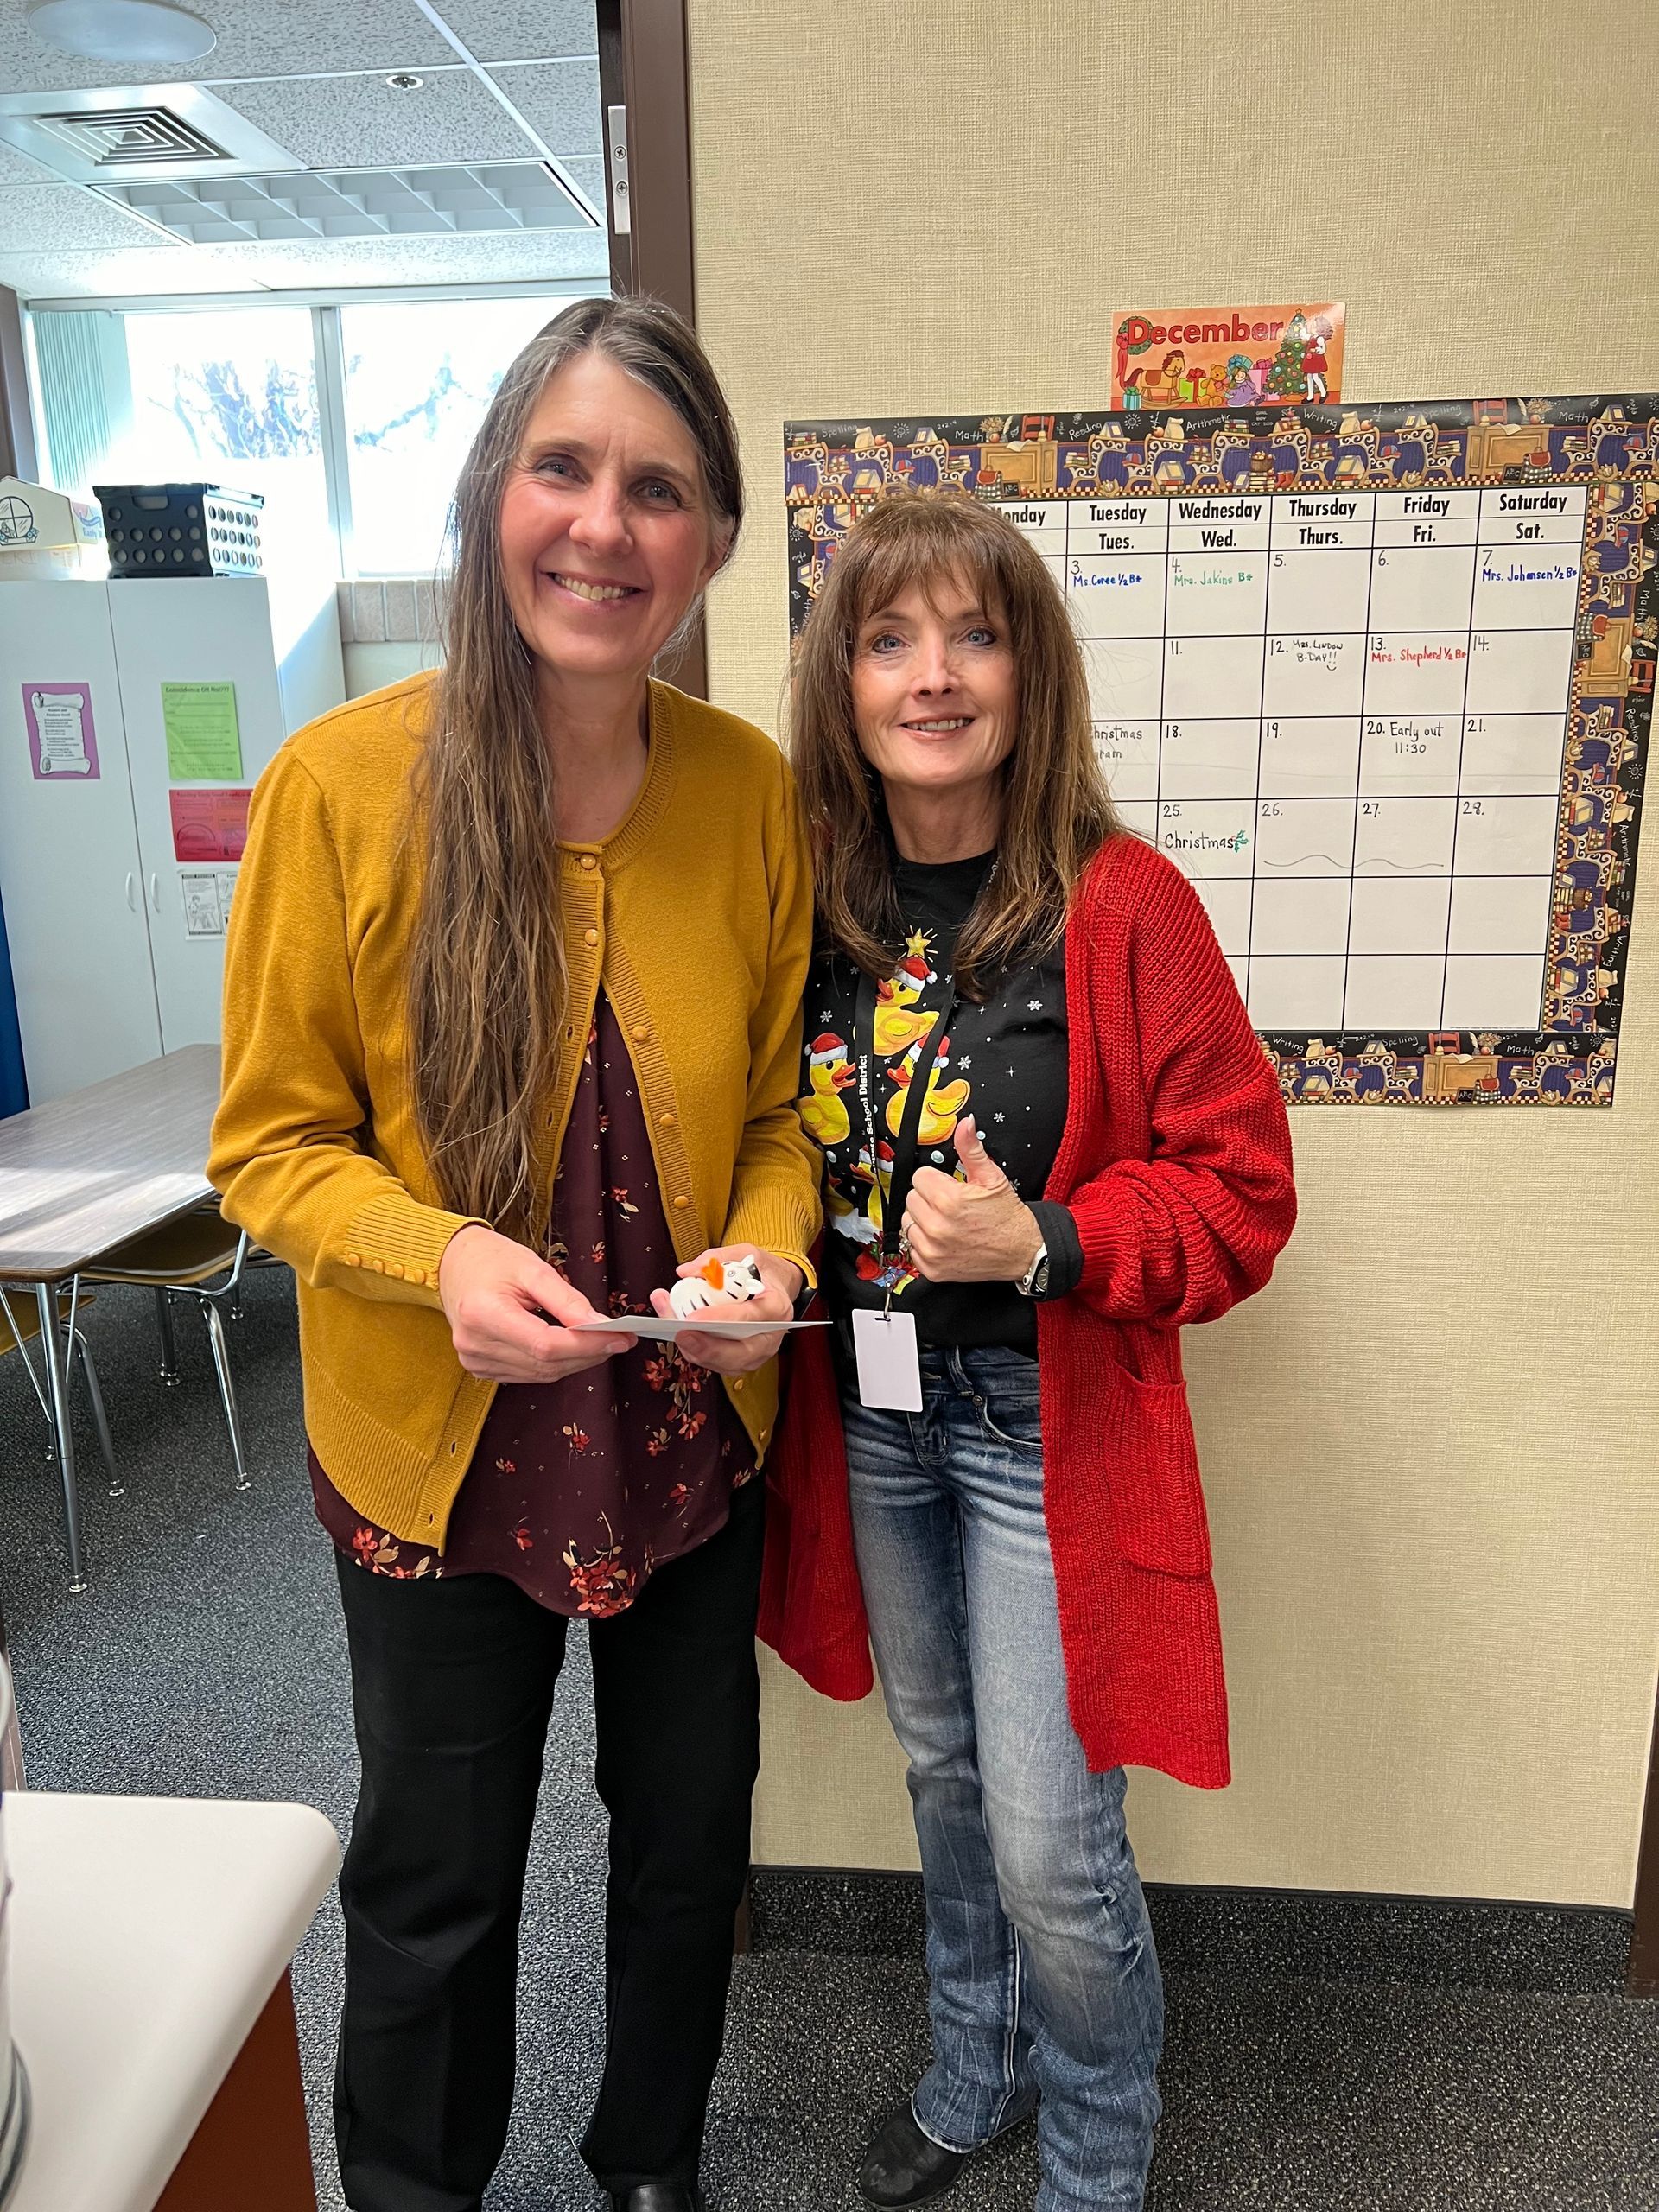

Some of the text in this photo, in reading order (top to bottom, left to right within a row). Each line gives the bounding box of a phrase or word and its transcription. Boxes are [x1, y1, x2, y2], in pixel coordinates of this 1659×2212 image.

[1128, 314, 1284, 346] December
[1423, 404, 1462, 418] Spelling
[1559, 411, 1588, 423] Math
[1304, 408, 1338, 431] Writing
[955, 430, 983, 442] Math
[1068, 422, 1103, 441] Reading
[1179, 499, 1262, 521] Wednesday
[1289, 498, 1357, 519] Thursday
[1404, 494, 1450, 516] Friday
[1499, 491, 1567, 513] Saturday
[1090, 503, 1147, 524] Tuesday
[1201, 529, 1236, 547] Wed.
[1299, 527, 1343, 544] Thurs.
[1413, 524, 1436, 542] Fri.
[1516, 523, 1544, 539] Sat.
[1099, 533, 1135, 550] Tues.
[1172, 557, 1182, 573] 4.
[1274, 554, 1287, 567] 5.
[1378, 550, 1389, 566] 6.
[1482, 550, 1493, 566] 7.
[1071, 560, 1083, 575] 3.
[1483, 569, 1503, 582] Mrs.
[1174, 575, 1198, 586] Mrs.
[1636, 589, 1650, 620] Math
[1171, 640, 1183, 656] 11.
[1270, 639, 1288, 656] 12.
[1370, 636, 1386, 651] 13.
[1473, 635, 1489, 651] 14.
[1371, 652, 1395, 663] Mrs.
[1400, 645, 1442, 667] Shepherd
[1092, 725, 1142, 741] hristmas
[1166, 724, 1182, 738] 18.
[1266, 722, 1282, 739] 19.
[1366, 721, 1445, 742] 20. Early out
[1467, 719, 1486, 733] 21.
[1395, 742, 1427, 753] 11:30
[1163, 804, 1182, 817] 25.
[1262, 803, 1283, 817] 26.
[1363, 803, 1381, 817] 27.
[1462, 801, 1484, 815] 28.
[1165, 830, 1234, 849] Christmas
[1603, 935, 1626, 967] Writing
[1273, 1034, 1304, 1054] Writing
[1382, 1036, 1419, 1047] Spelling
[1506, 1045, 1535, 1055] Math
[858, 1054, 868, 1096] District
[860, 1097, 874, 1135] School
